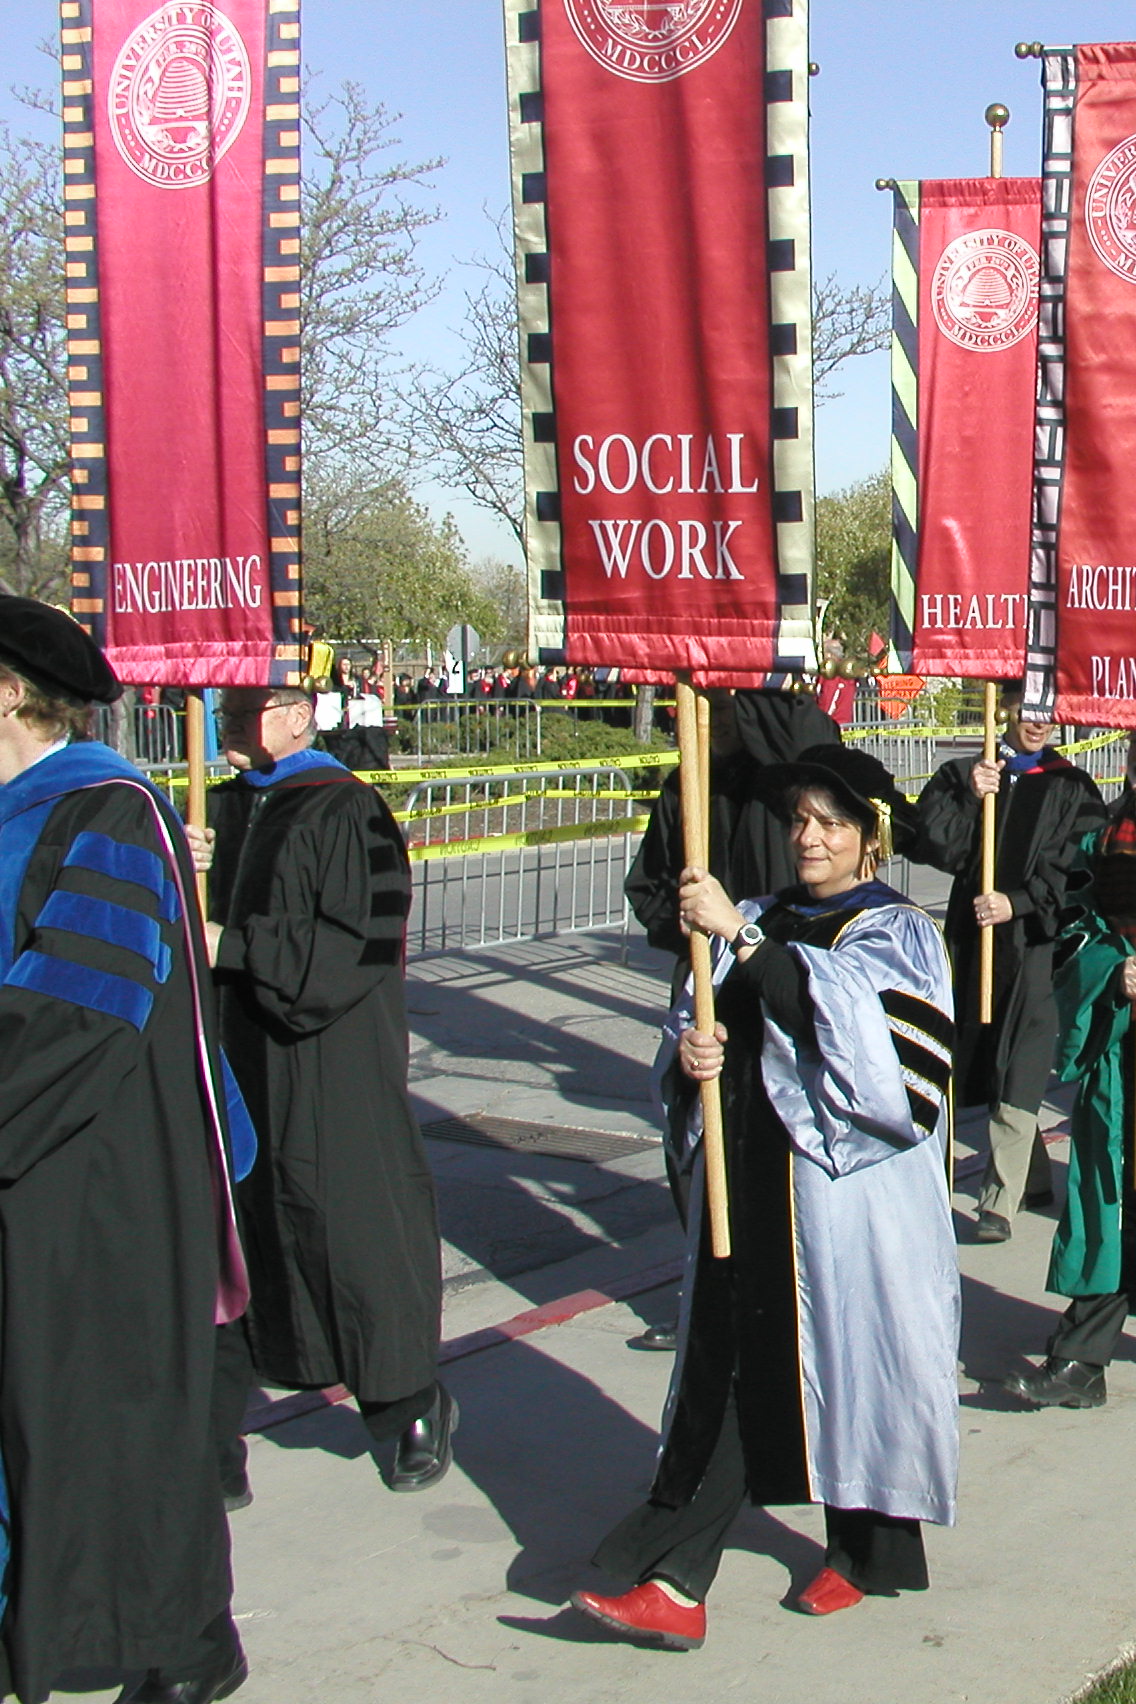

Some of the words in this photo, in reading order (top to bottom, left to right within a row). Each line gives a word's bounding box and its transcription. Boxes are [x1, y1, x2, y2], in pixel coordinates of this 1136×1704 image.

[115, 8, 199, 115] UNIVERSITY
[214, 30, 245, 98] UTAH
[601, 34, 711, 73] MDCCCL
[950, 325, 1023, 347] MDCCCL
[573, 433, 759, 495] SOCIAL
[588, 518, 745, 580] WORK
